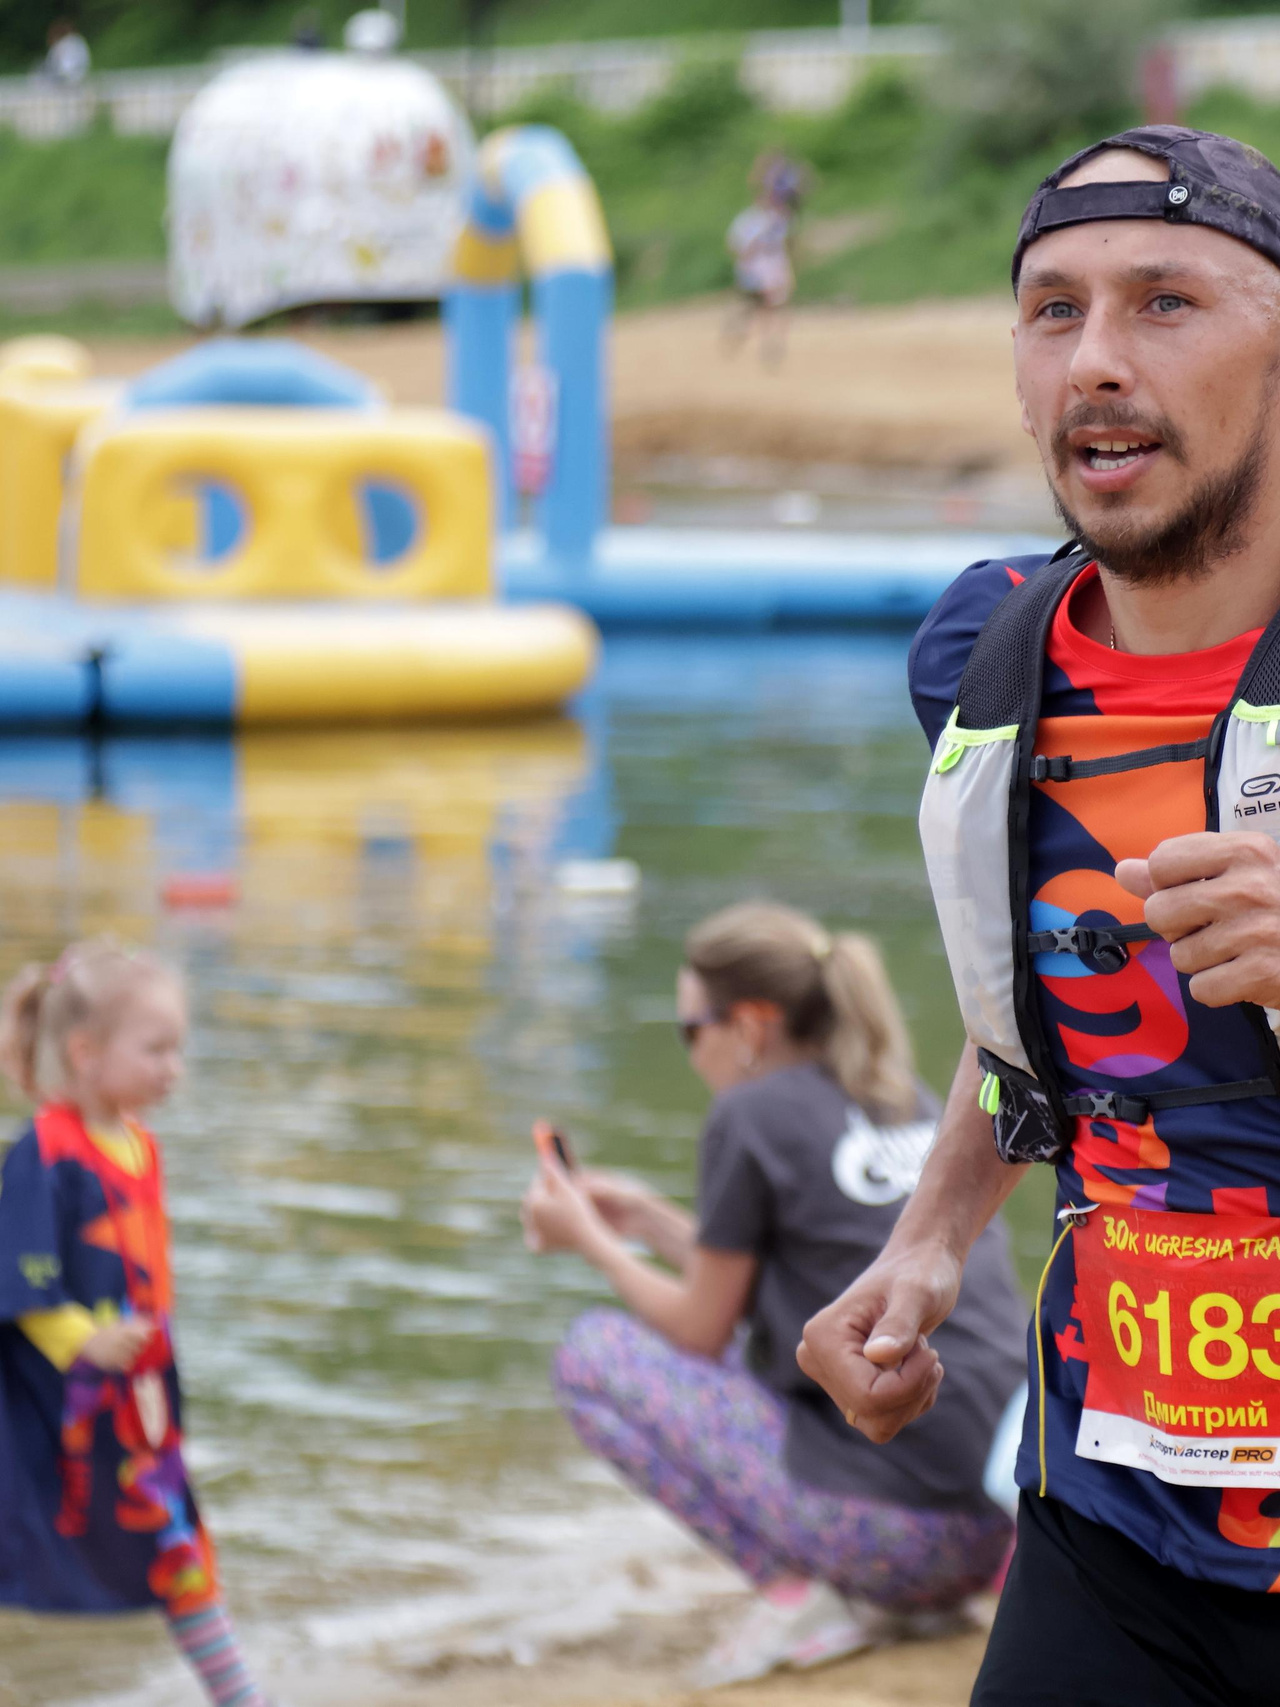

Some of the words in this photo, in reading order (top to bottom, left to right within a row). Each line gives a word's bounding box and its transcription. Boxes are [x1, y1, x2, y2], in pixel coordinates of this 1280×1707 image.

[1144, 1234, 1234, 1261] UGRESHA
[1143, 1390, 1268, 1434] Дмитрий
[1233, 1449, 1274, 1462] PRO
